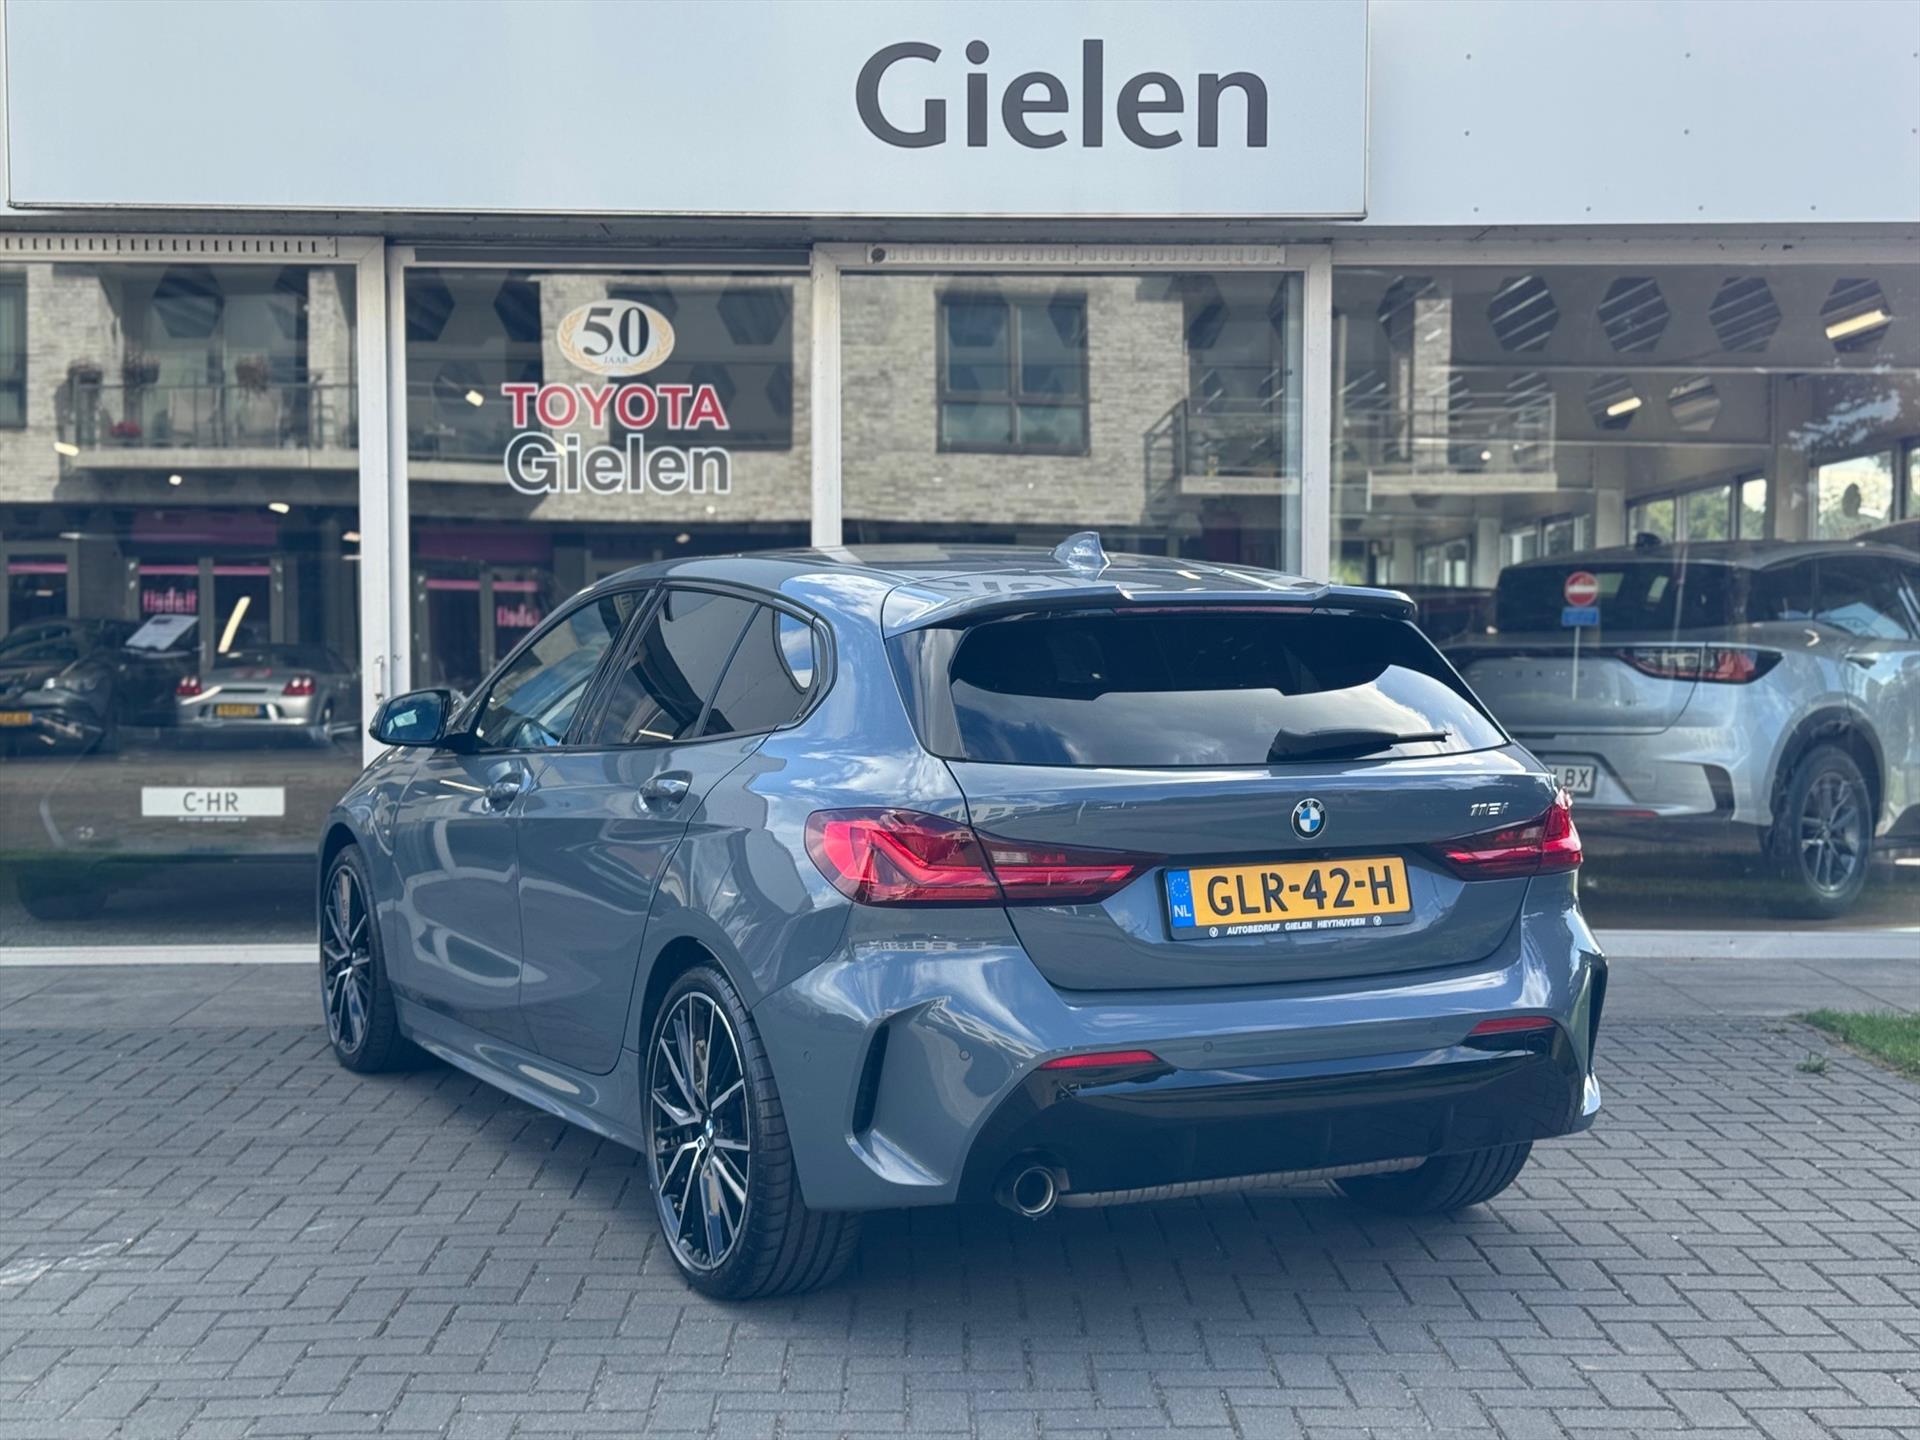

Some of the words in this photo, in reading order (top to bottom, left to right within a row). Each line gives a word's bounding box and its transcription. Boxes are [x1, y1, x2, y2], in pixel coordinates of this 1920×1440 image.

[855, 39, 1268, 149] Gielen
[582, 307, 650, 357] 50
[502, 383, 730, 430] TOYOTA
[504, 432, 731, 495] Gielen
[183, 791, 239, 812] C-HR
[1174, 904, 1192, 918] NL
[1207, 865, 1396, 916] GLR-42-H
[1226, 923, 1281, 936] AUTOBEDRIJF
[1285, 920, 1313, 931] GIELEN
[1317, 917, 1366, 929] HEYTHUYSEN
